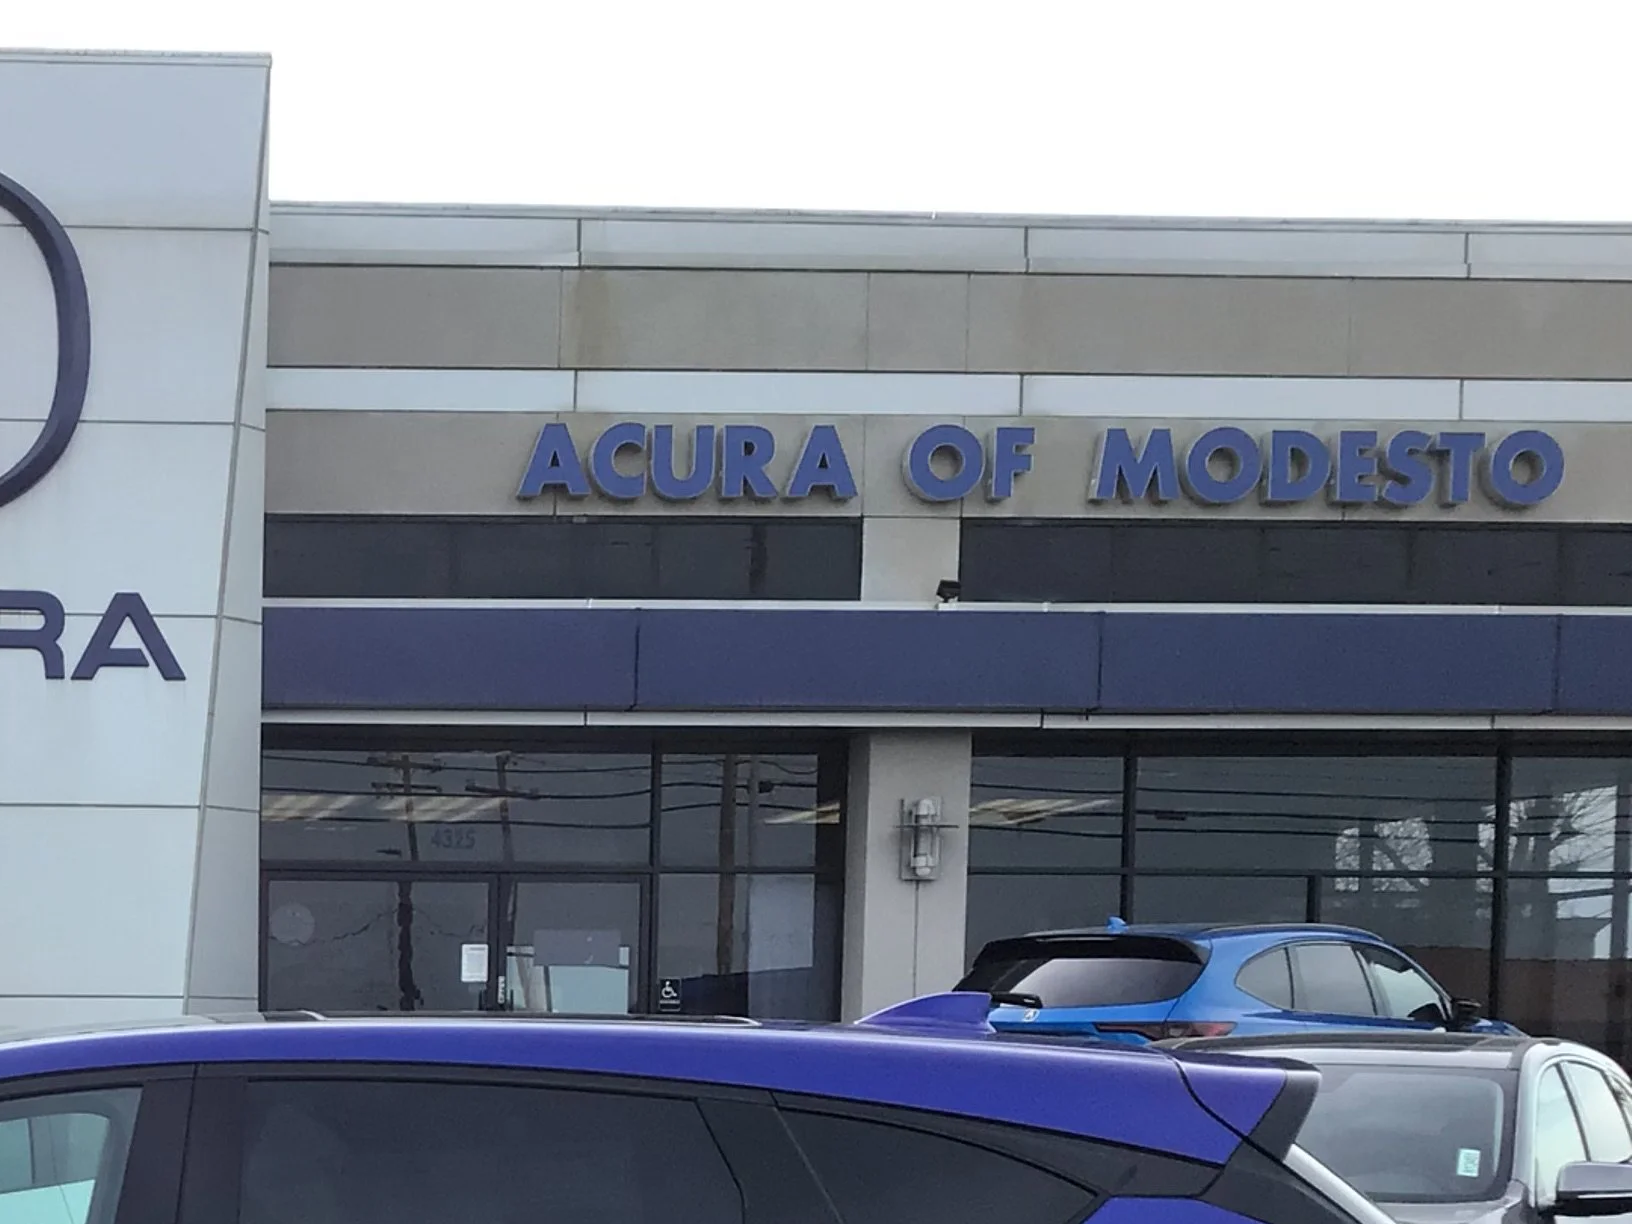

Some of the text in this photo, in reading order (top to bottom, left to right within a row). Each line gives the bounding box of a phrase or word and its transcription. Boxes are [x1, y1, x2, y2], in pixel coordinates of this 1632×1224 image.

[516, 422, 1565, 508] ACURA OF MODESTO
